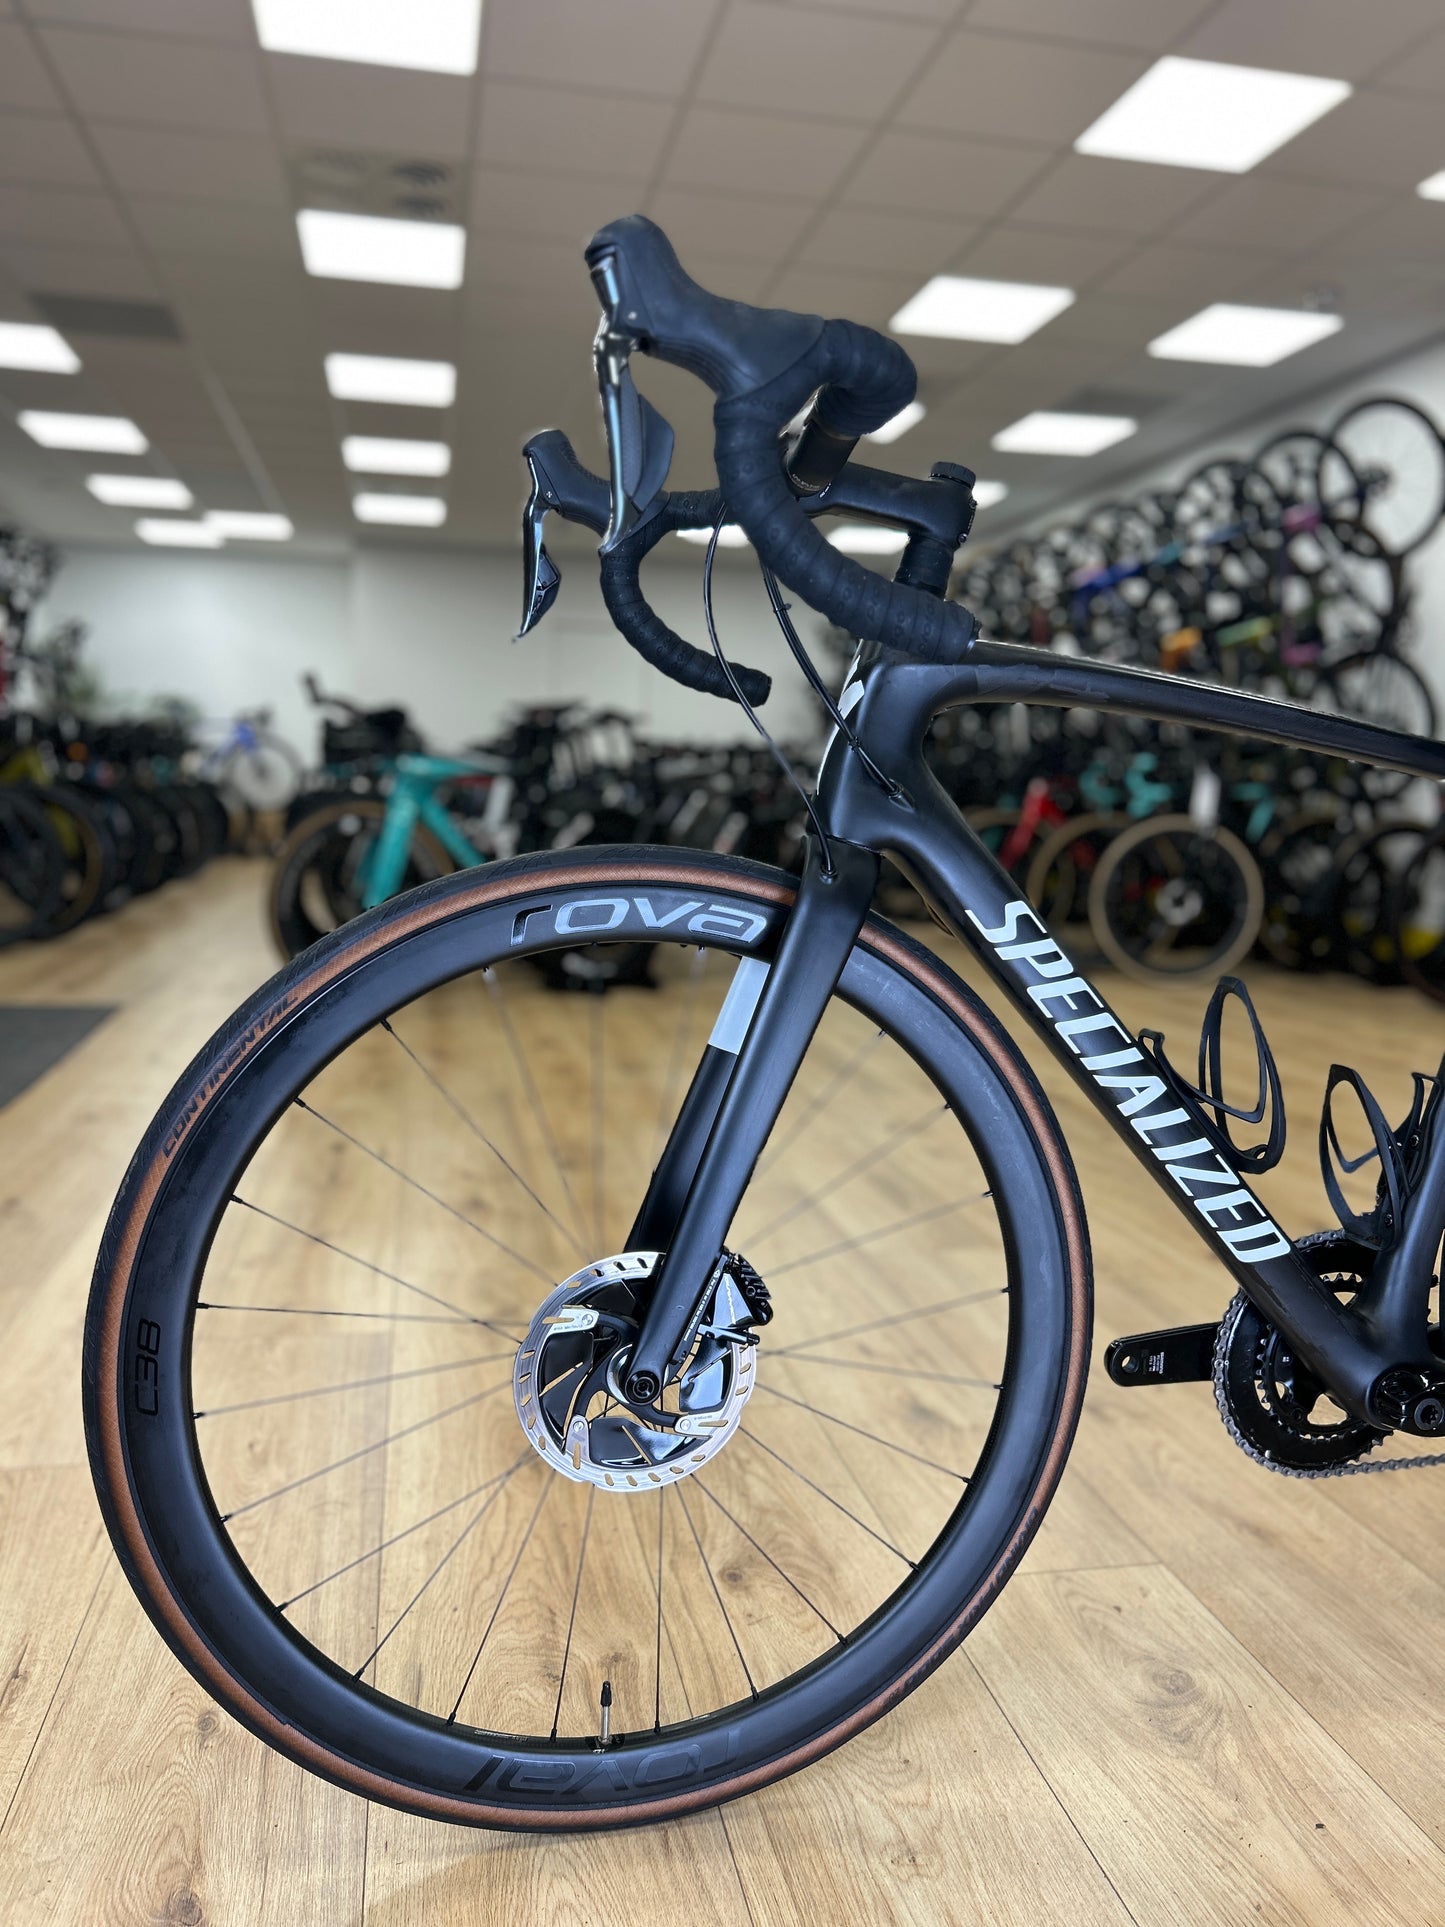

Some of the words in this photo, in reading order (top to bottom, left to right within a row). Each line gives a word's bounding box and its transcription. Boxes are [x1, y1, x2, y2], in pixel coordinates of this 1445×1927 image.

[161, 996, 298, 1158] CONTINENTAL
[965, 900, 1291, 1263] SPECIALIZED
[134, 1318, 161, 1416] C38
[463, 1728, 743, 1795] roval
